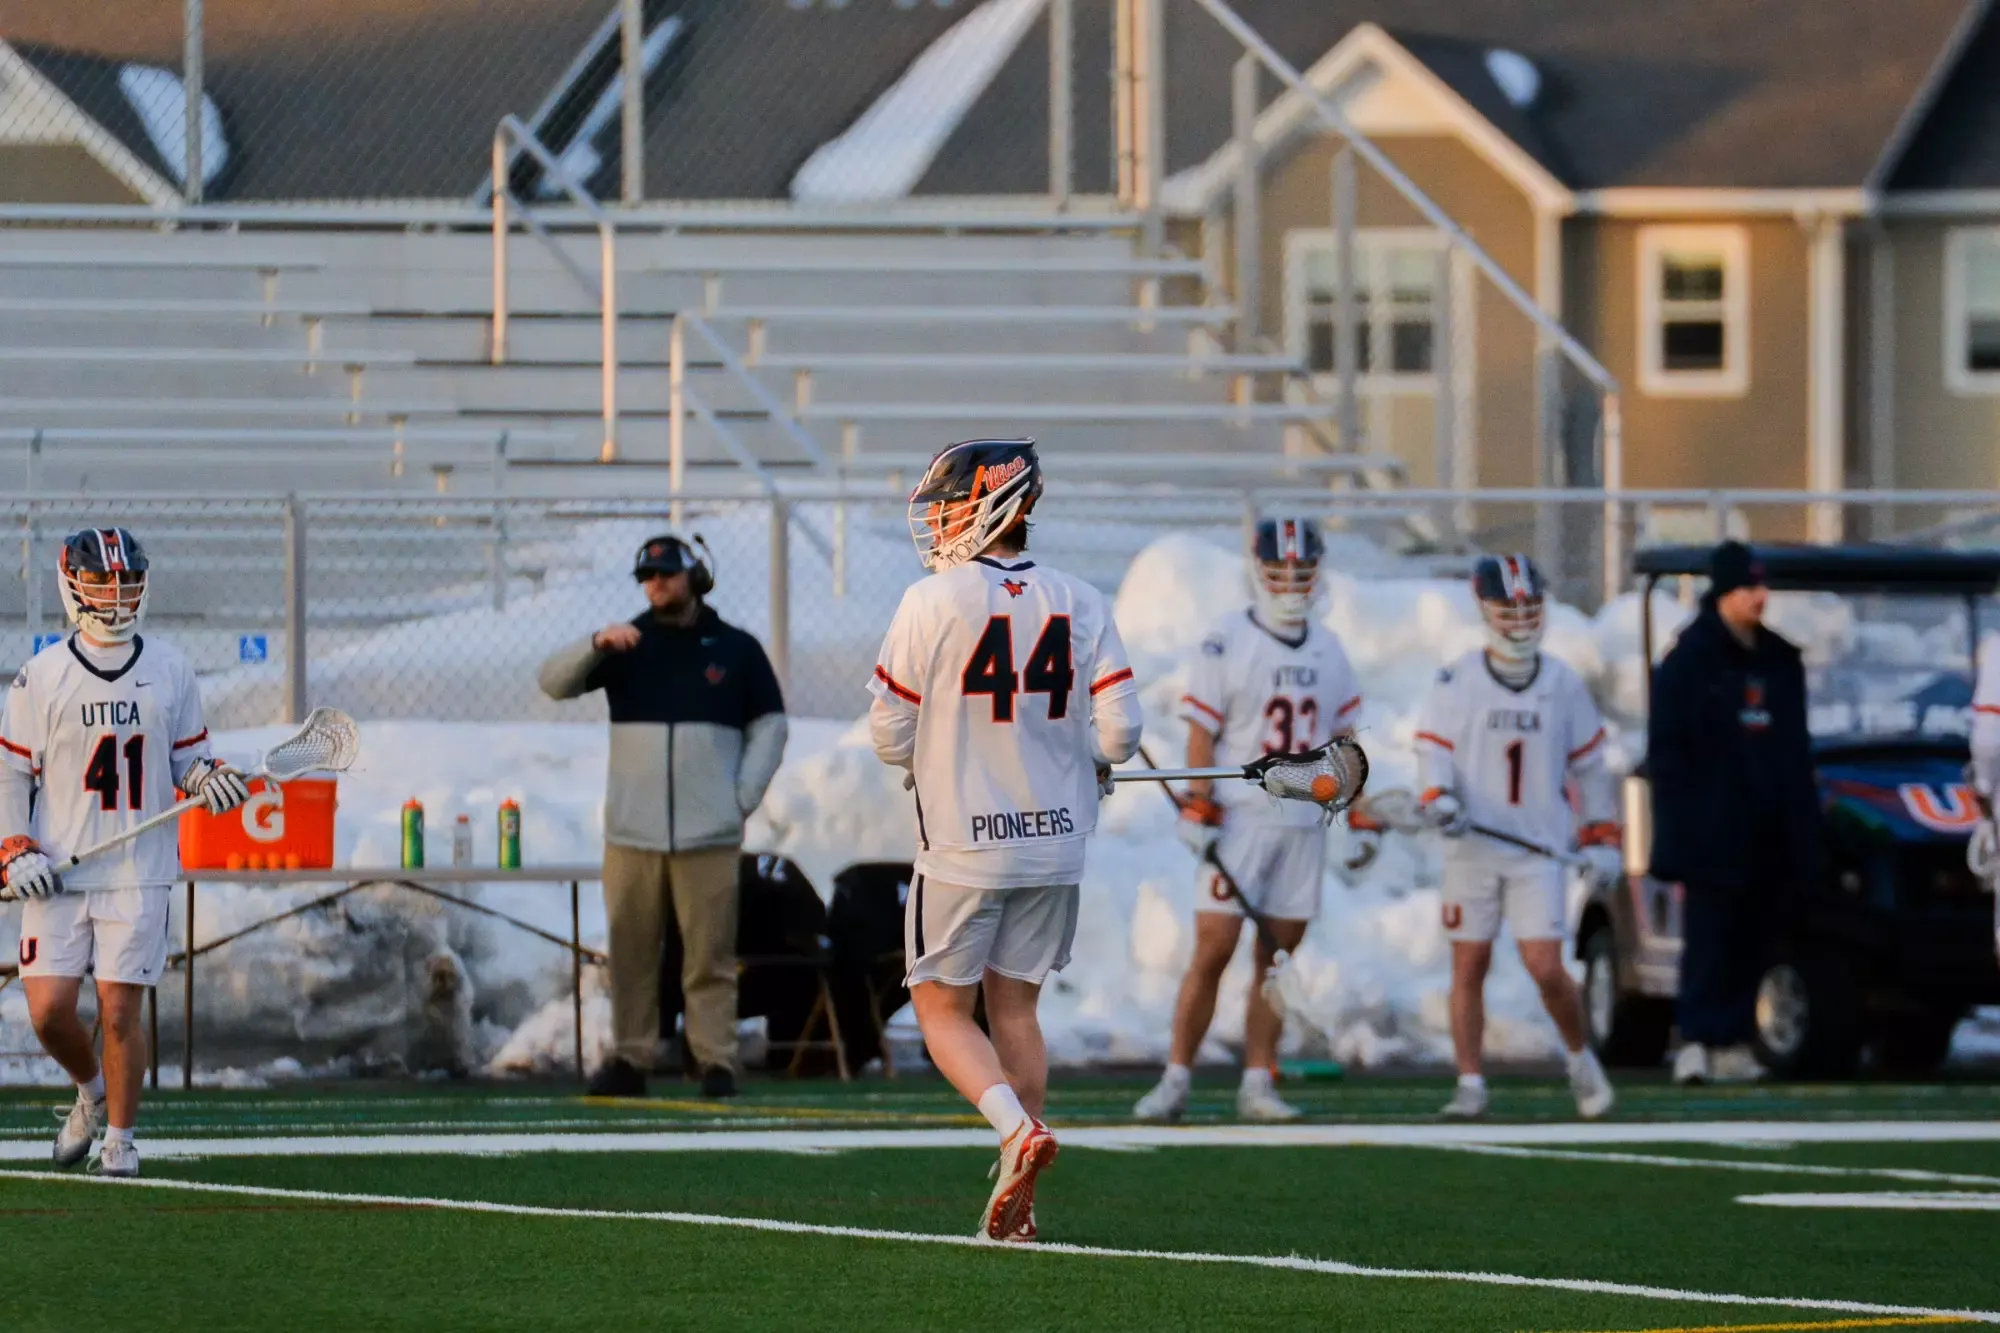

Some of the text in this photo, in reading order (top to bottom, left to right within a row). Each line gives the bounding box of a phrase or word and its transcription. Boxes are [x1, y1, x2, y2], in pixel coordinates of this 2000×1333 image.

[946, 536, 980, 566] MOM
[961, 614, 1075, 723] 44
[81, 701, 140, 727] UTICA
[83, 733, 144, 812] 41
[1505, 739, 1525, 807] 1
[241, 790, 285, 842] G
[971, 807, 1074, 842] PIONEERS
[1898, 783, 1981, 832] U
[1442, 904, 1462, 930] U
[20, 936, 38, 967] U
